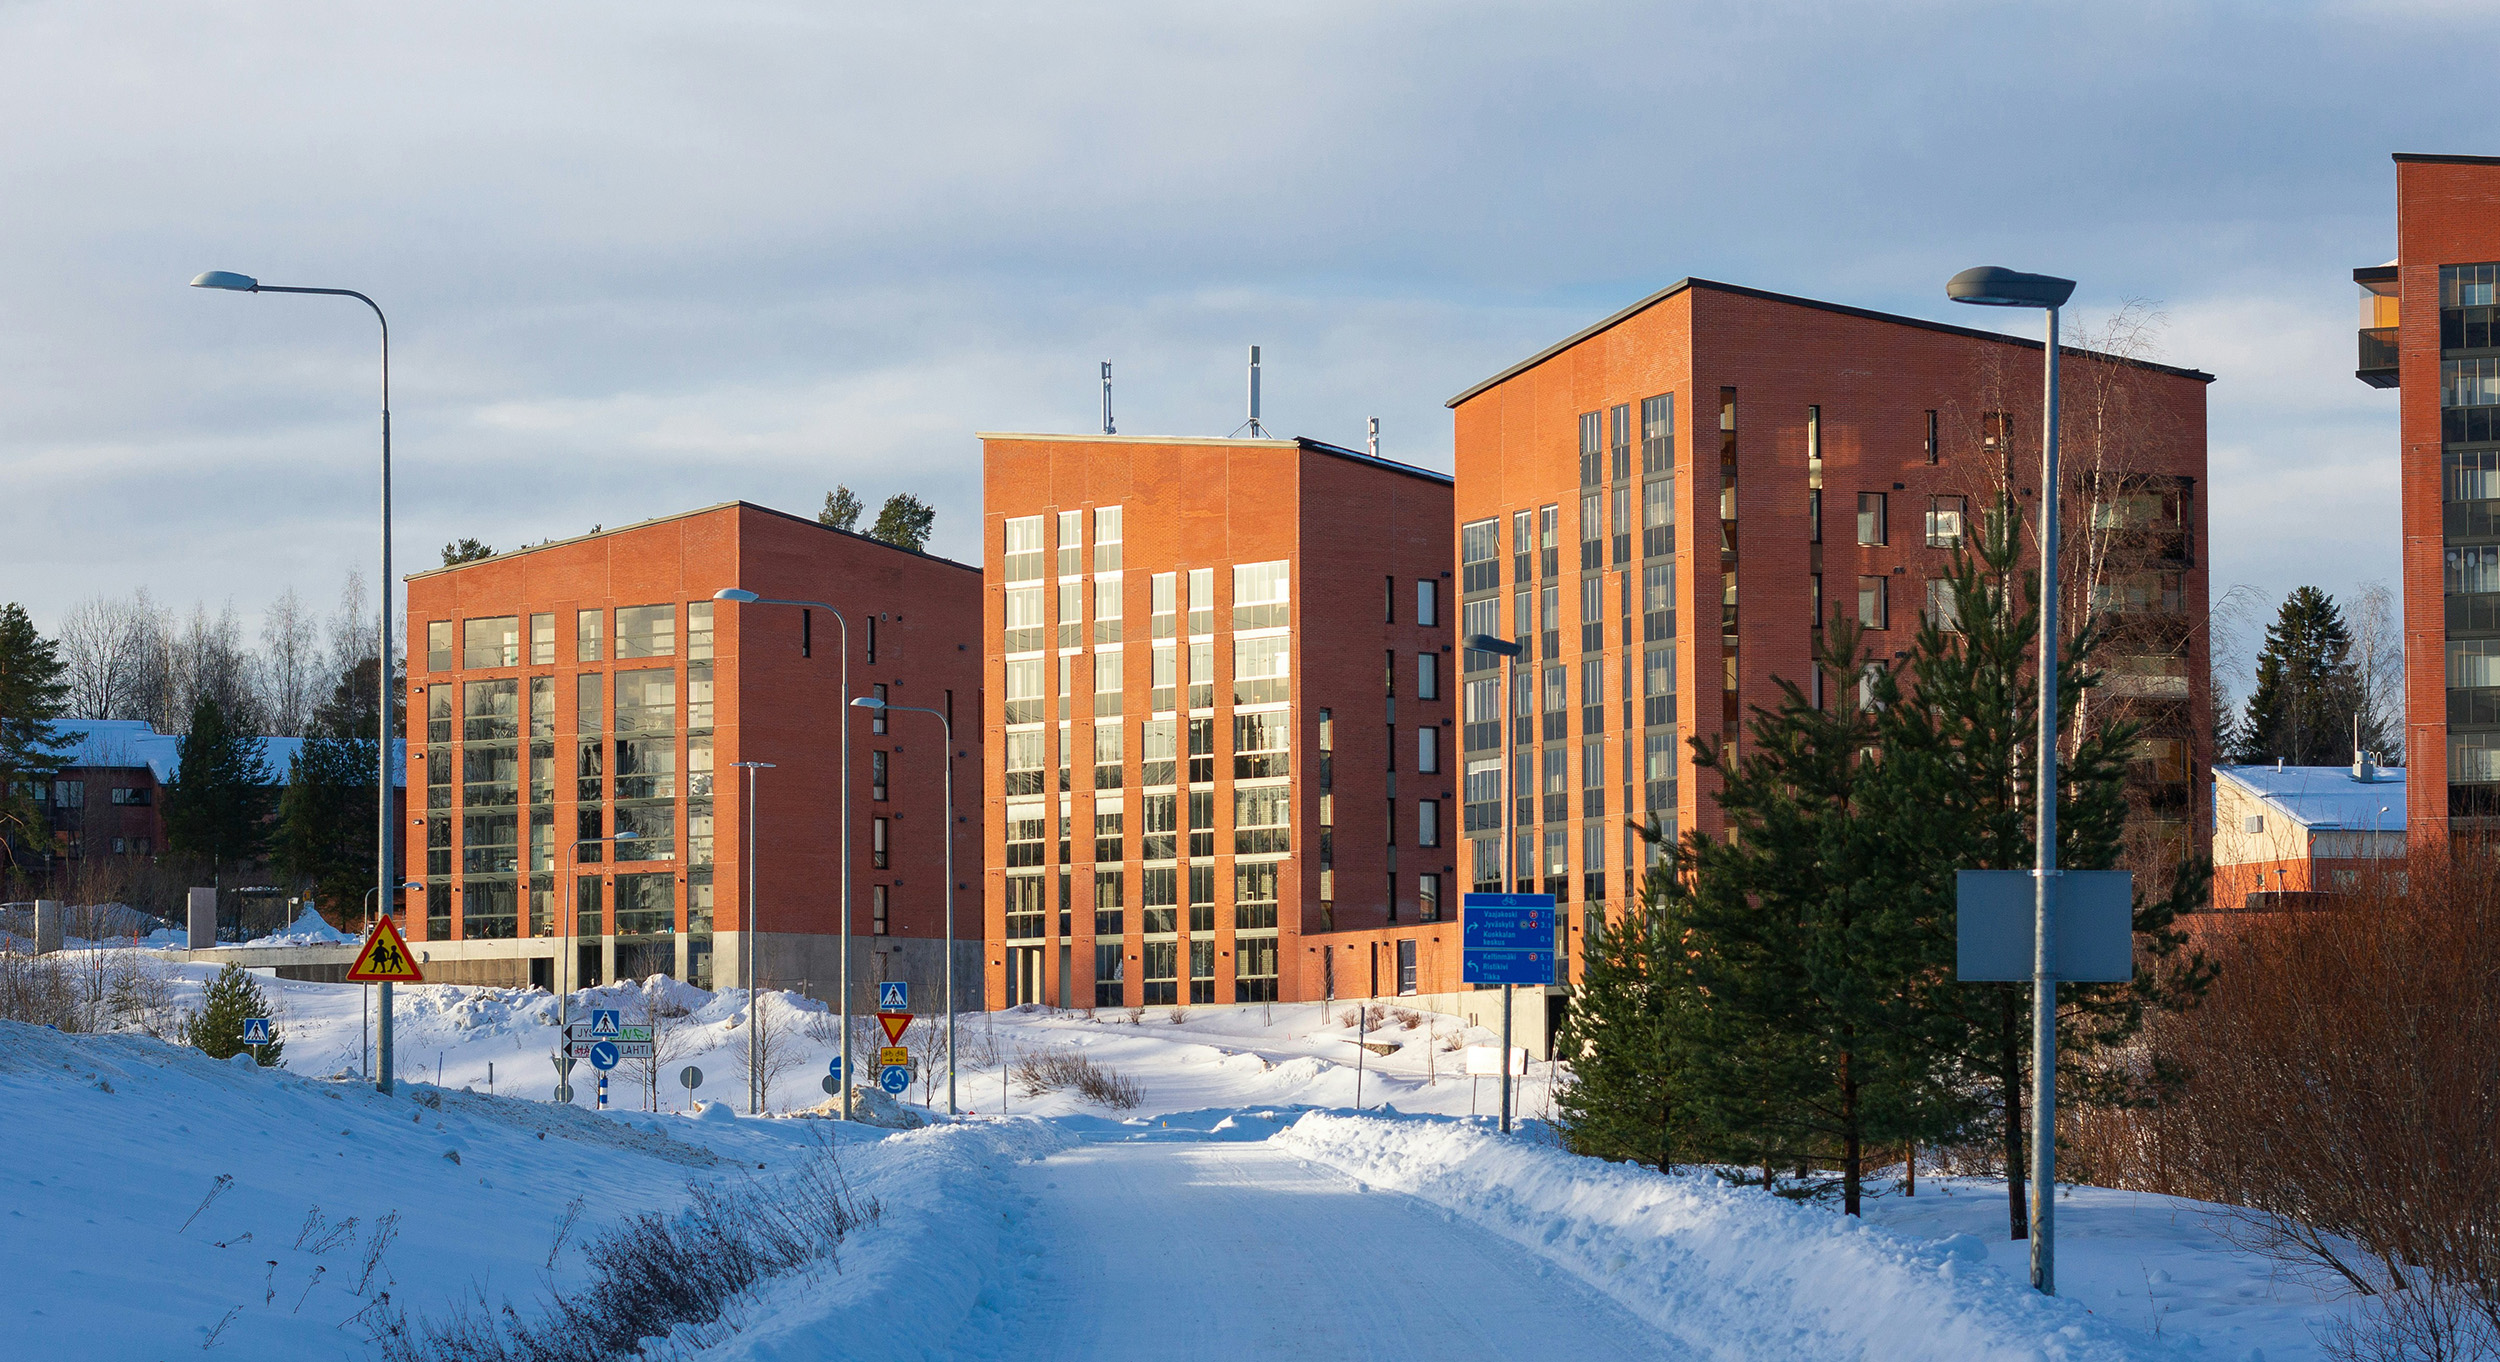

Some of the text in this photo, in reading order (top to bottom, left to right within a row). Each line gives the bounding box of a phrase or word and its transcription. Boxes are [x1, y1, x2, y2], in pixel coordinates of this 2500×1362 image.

[1483, 910, 1518, 919] Vaajakoski
[1483, 921, 1515, 929] Jyväskylä
[1483, 938, 1505, 946] keskus
